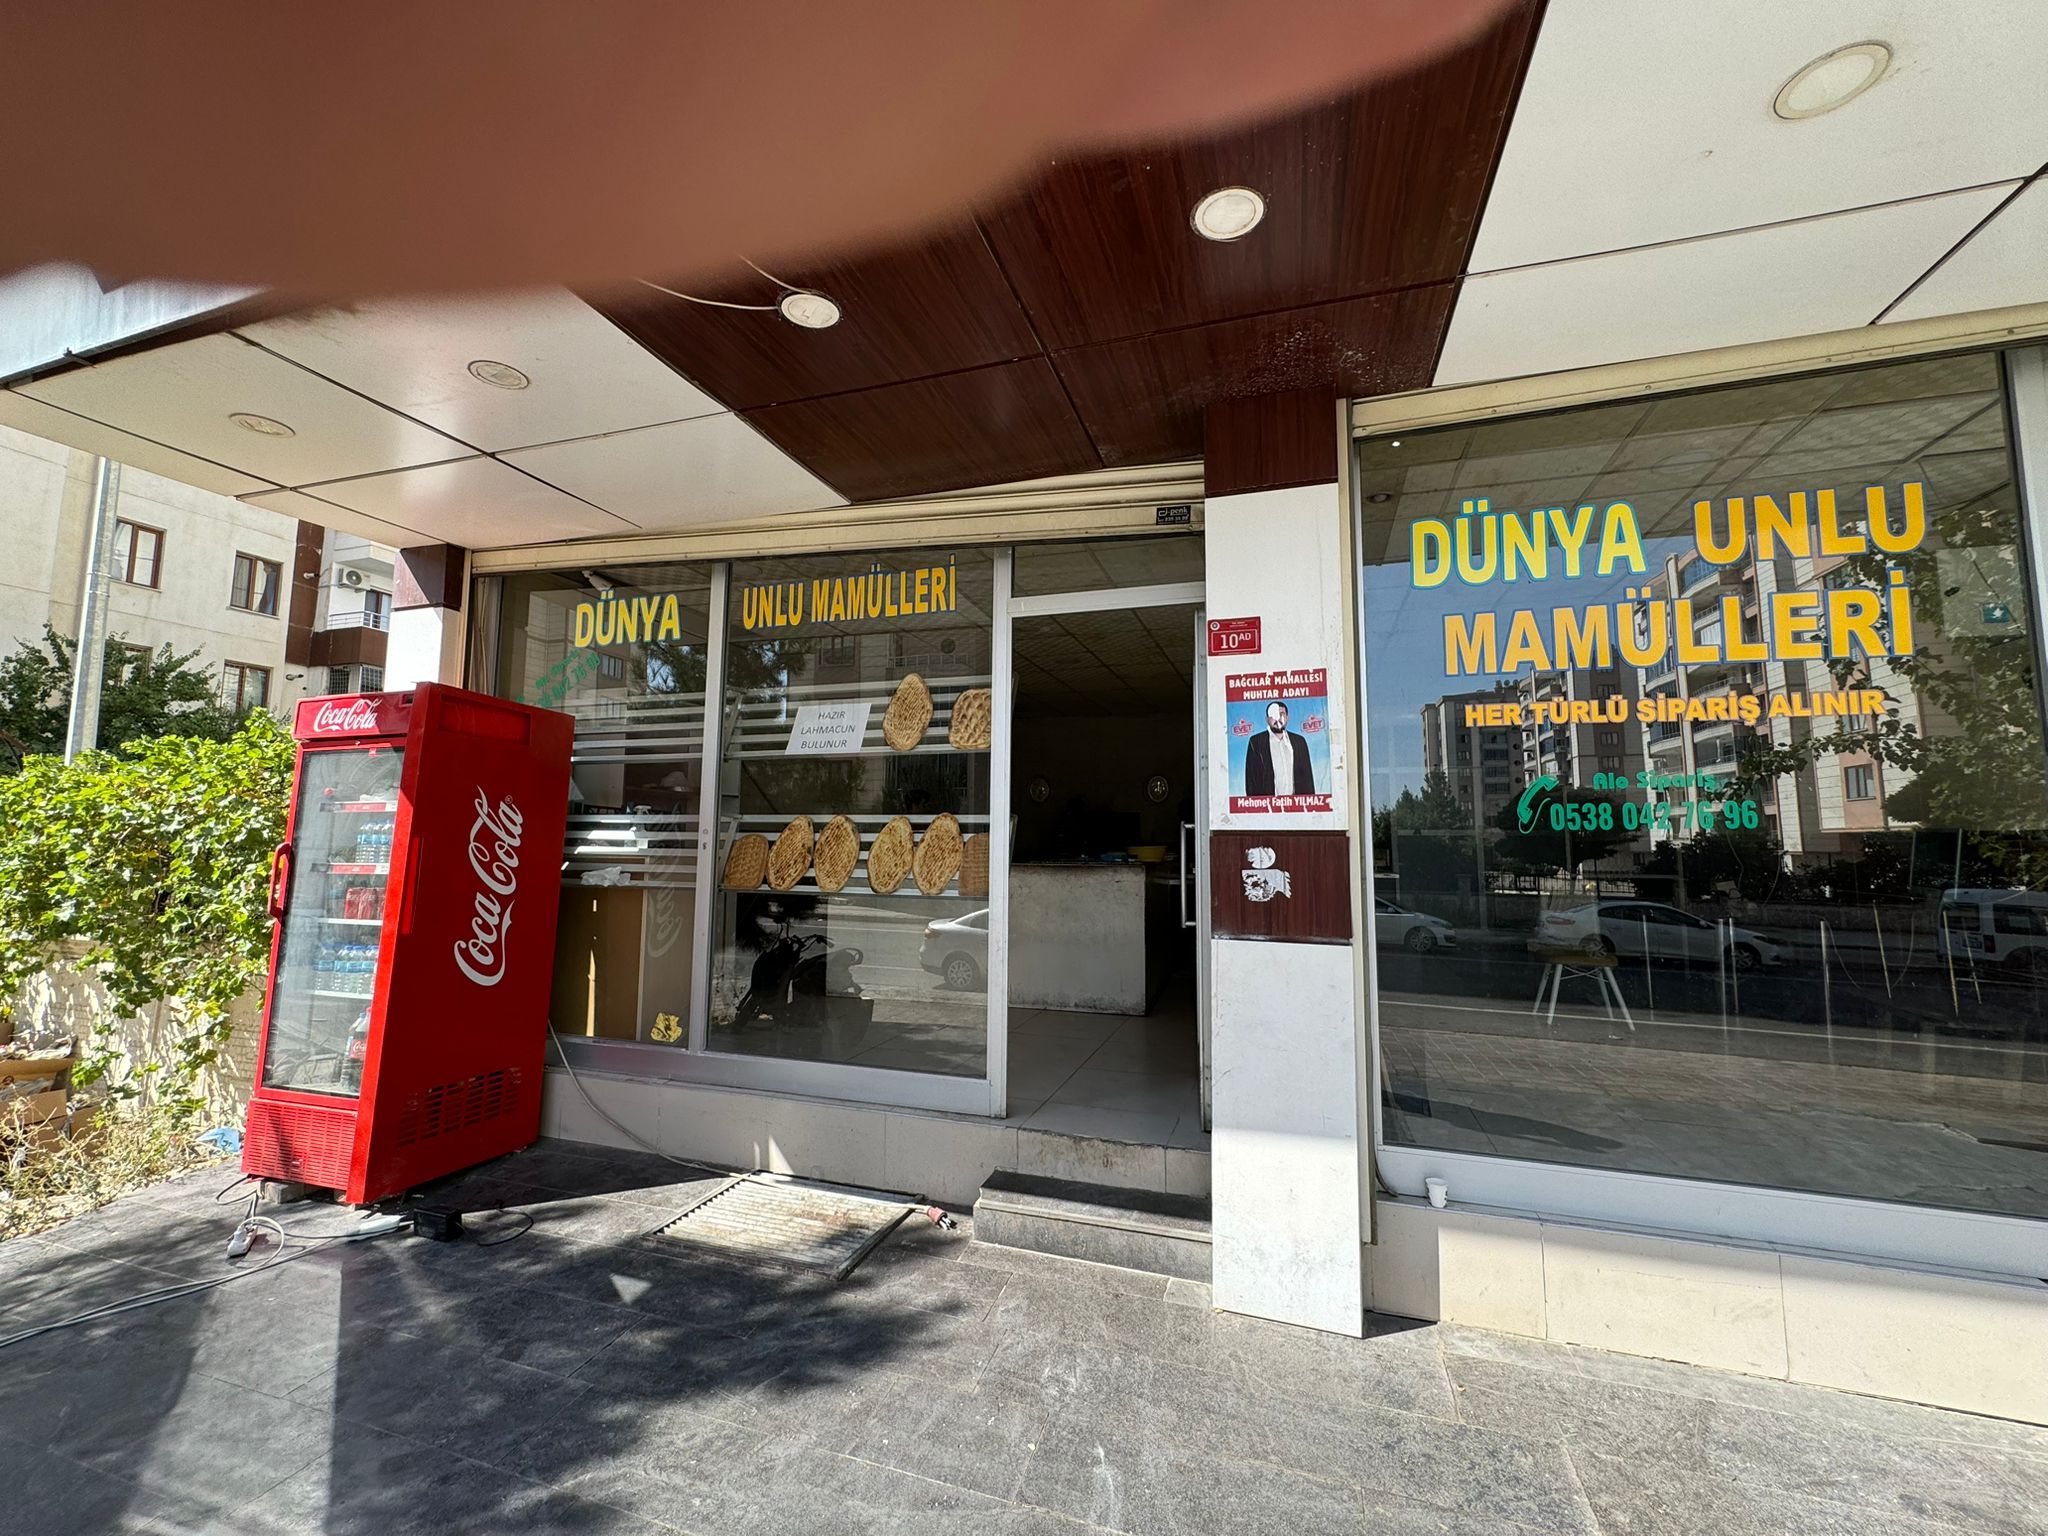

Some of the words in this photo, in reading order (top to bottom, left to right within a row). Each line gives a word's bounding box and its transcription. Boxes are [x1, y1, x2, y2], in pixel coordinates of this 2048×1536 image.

[1410, 498, 1648, 589] DÜNYA
[1691, 480, 1927, 565] UNLU
[575, 590, 682, 648] DÜNYA
[742, 581, 804, 630] UNLU
[810, 554, 957, 623] MAMÜLLERİ
[1443, 567, 1916, 677] MAMÜLLERİ
[1274, 672, 1323, 686] MAHALLESİ
[1243, 689, 1279, 700] MUHTAR
[1282, 687, 1310, 698] ADAYI
[817, 710, 846, 720] HAZIR
[1465, 703, 1521, 728] HER
[1529, 695, 1629, 726] TÜRLÜ
[1636, 691, 1761, 727] SİPARİŞ
[1768, 689, 1887, 718] ALINIR
[800, 725, 856, 735] LAHMACUN
[1302, 720, 1323, 730] EVET
[800, 740, 848, 749] BULUNUR
[1237, 797, 1270, 808] Mehmet
[1294, 796, 1325, 807] YILMAZ
[1550, 802, 1614, 831] 0538
[1622, 802, 1671, 830] 042
[1682, 801, 1715, 830] 76
[1722, 801, 1759, 830] 96
